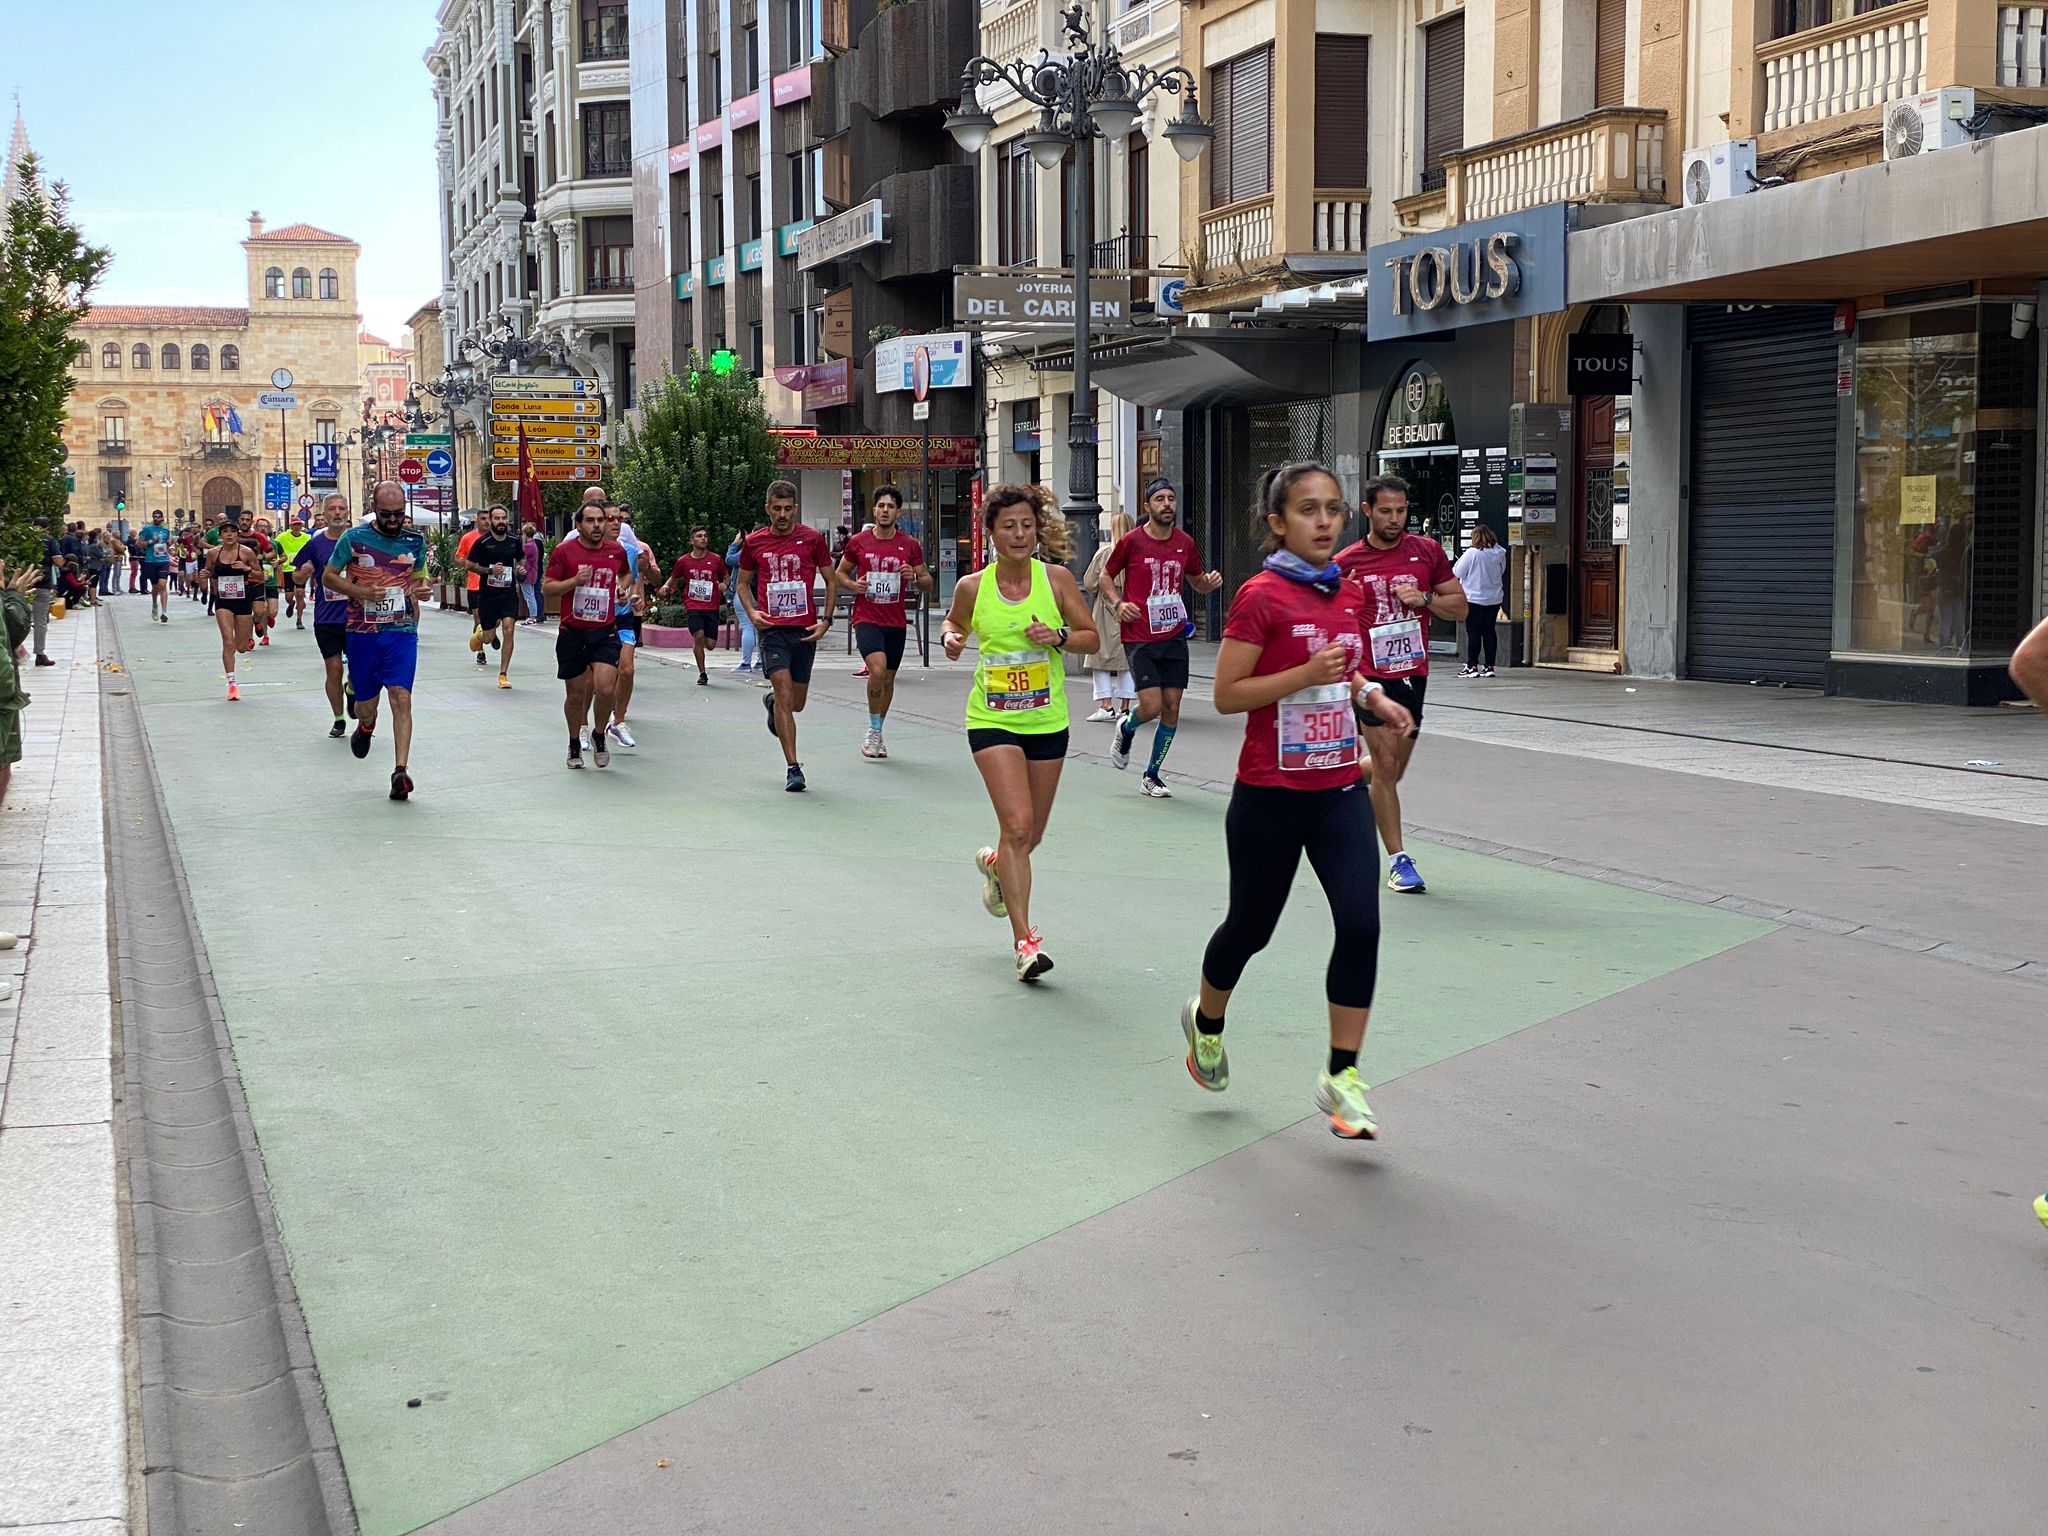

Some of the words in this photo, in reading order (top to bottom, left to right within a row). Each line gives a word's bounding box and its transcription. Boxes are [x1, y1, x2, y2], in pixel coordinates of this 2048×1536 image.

[1385, 231, 1521, 316] TOUS
[1016, 283, 1073, 294] JOYERIA
[967, 298, 1011, 316] DEL
[1023, 299, 1120, 318] CAREN
[1573, 357, 1628, 372] TOUS
[261, 394, 295, 404] Cámara
[1408, 383, 1422, 402] BE
[1014, 420, 1040, 433] ESTRELLA
[1389, 426, 1402, 444] BE
[1404, 422, 1445, 443] BEAUTY
[780, 437, 844, 449] ROYAL
[534, 447, 565, 455] Antonio
[224, 583, 238, 591] 699
[875, 582, 891, 594] 614
[375, 599, 395, 611] 557
[584, 598, 600, 610] 291
[777, 593, 797, 606] 276
[1159, 607, 1179, 621] 306
[1385, 637, 1412, 657] 278
[1007, 671, 1030, 692] 36
[1303, 711, 1343, 742] 350
